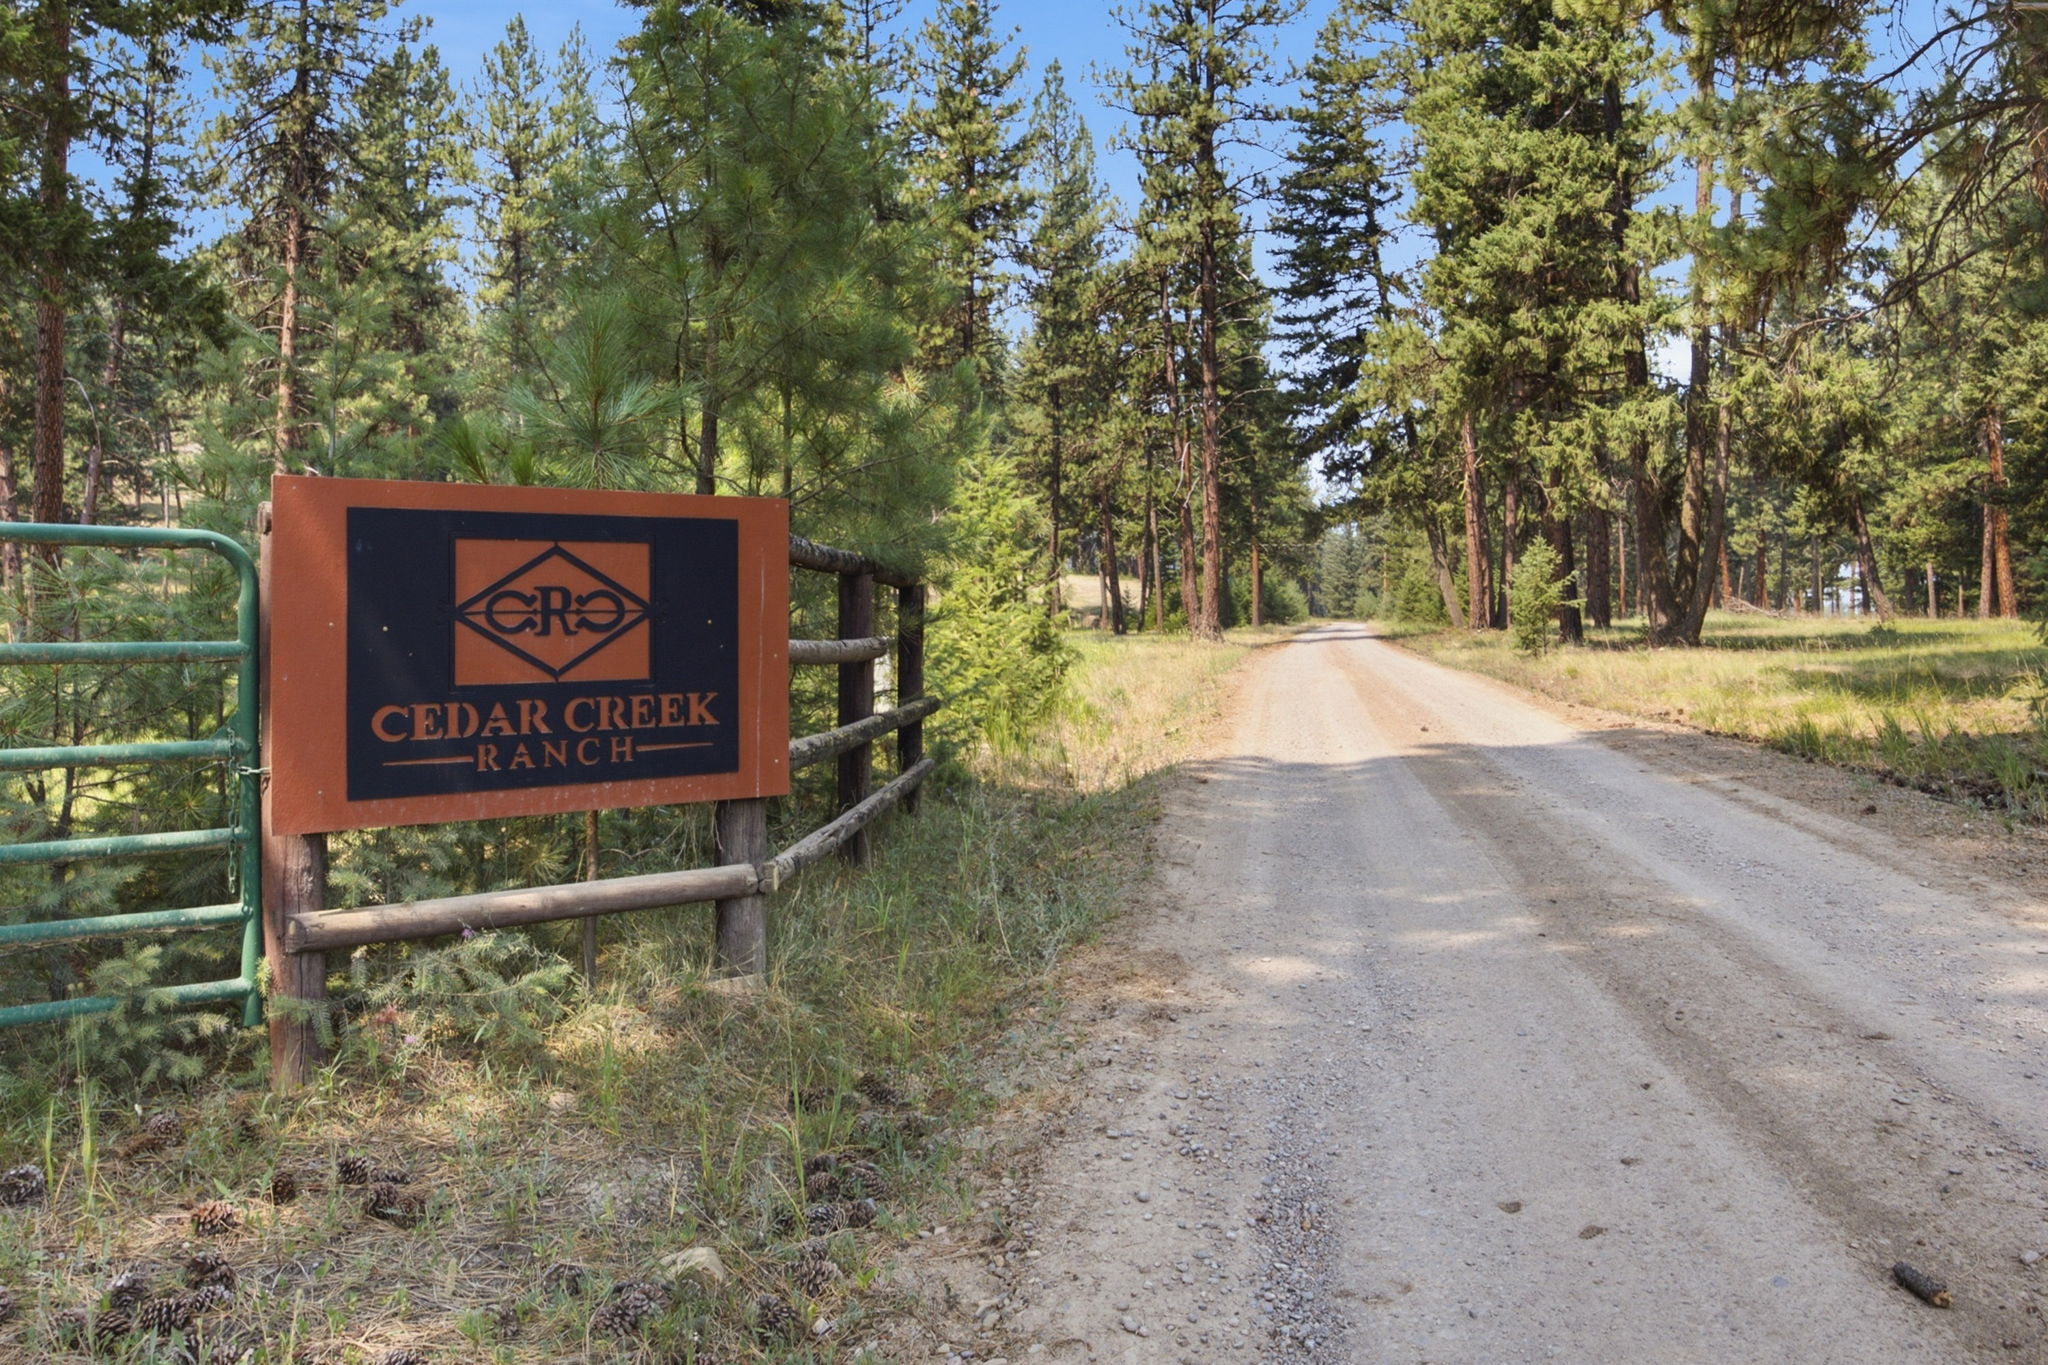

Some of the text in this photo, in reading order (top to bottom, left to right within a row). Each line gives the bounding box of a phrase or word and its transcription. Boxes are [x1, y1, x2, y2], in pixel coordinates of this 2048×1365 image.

[371, 692, 720, 743] CEDAR CREEK
[476, 736, 634, 772] RANCH
